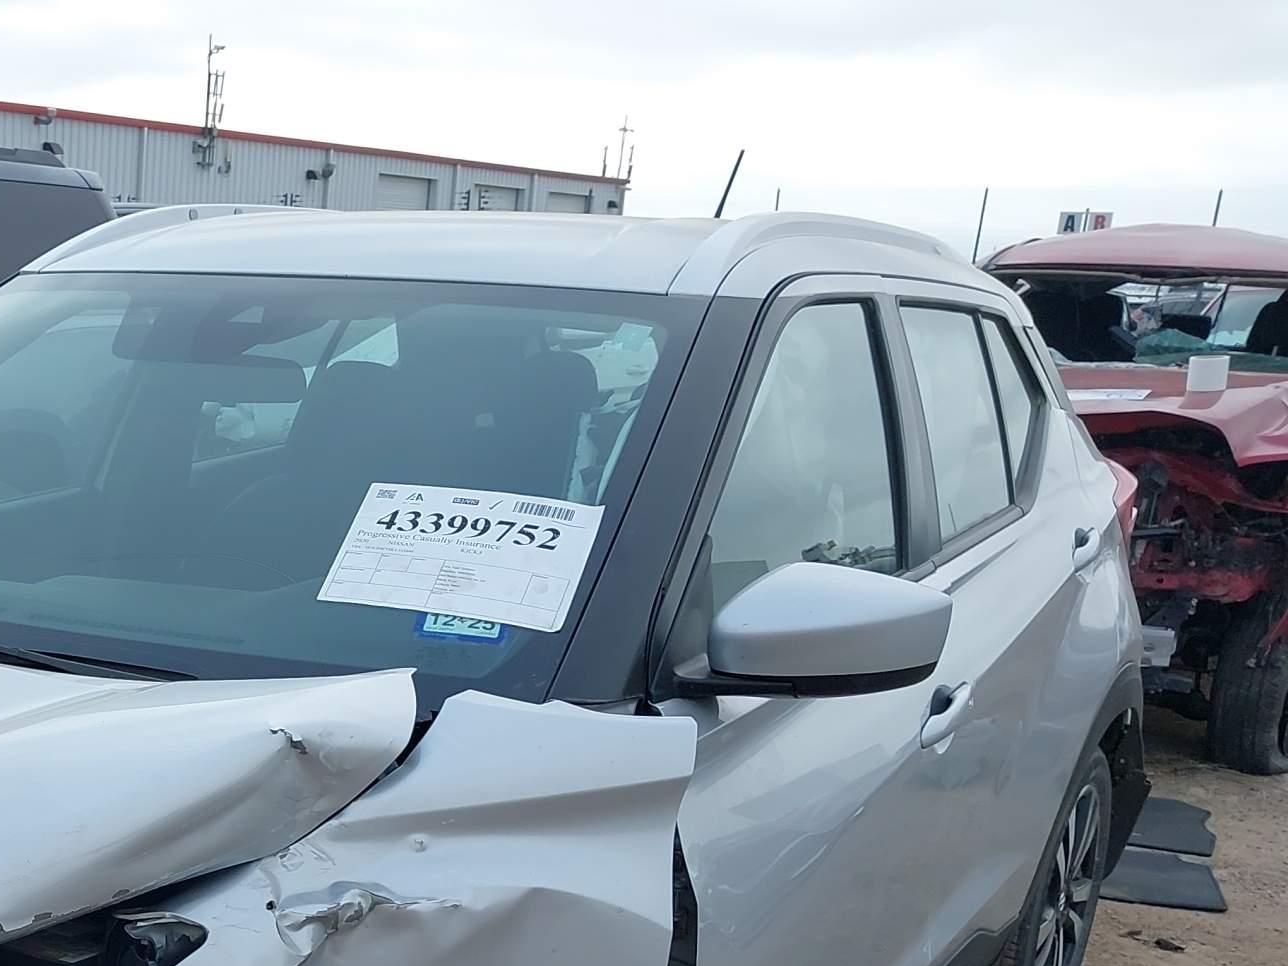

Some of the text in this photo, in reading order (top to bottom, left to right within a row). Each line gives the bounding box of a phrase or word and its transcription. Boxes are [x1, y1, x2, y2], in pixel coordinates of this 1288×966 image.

[1063, 215, 1075, 232] A
[357, 529, 502, 551] Progressive Casualty Insurance
[376, 509, 561, 551] 43399752
